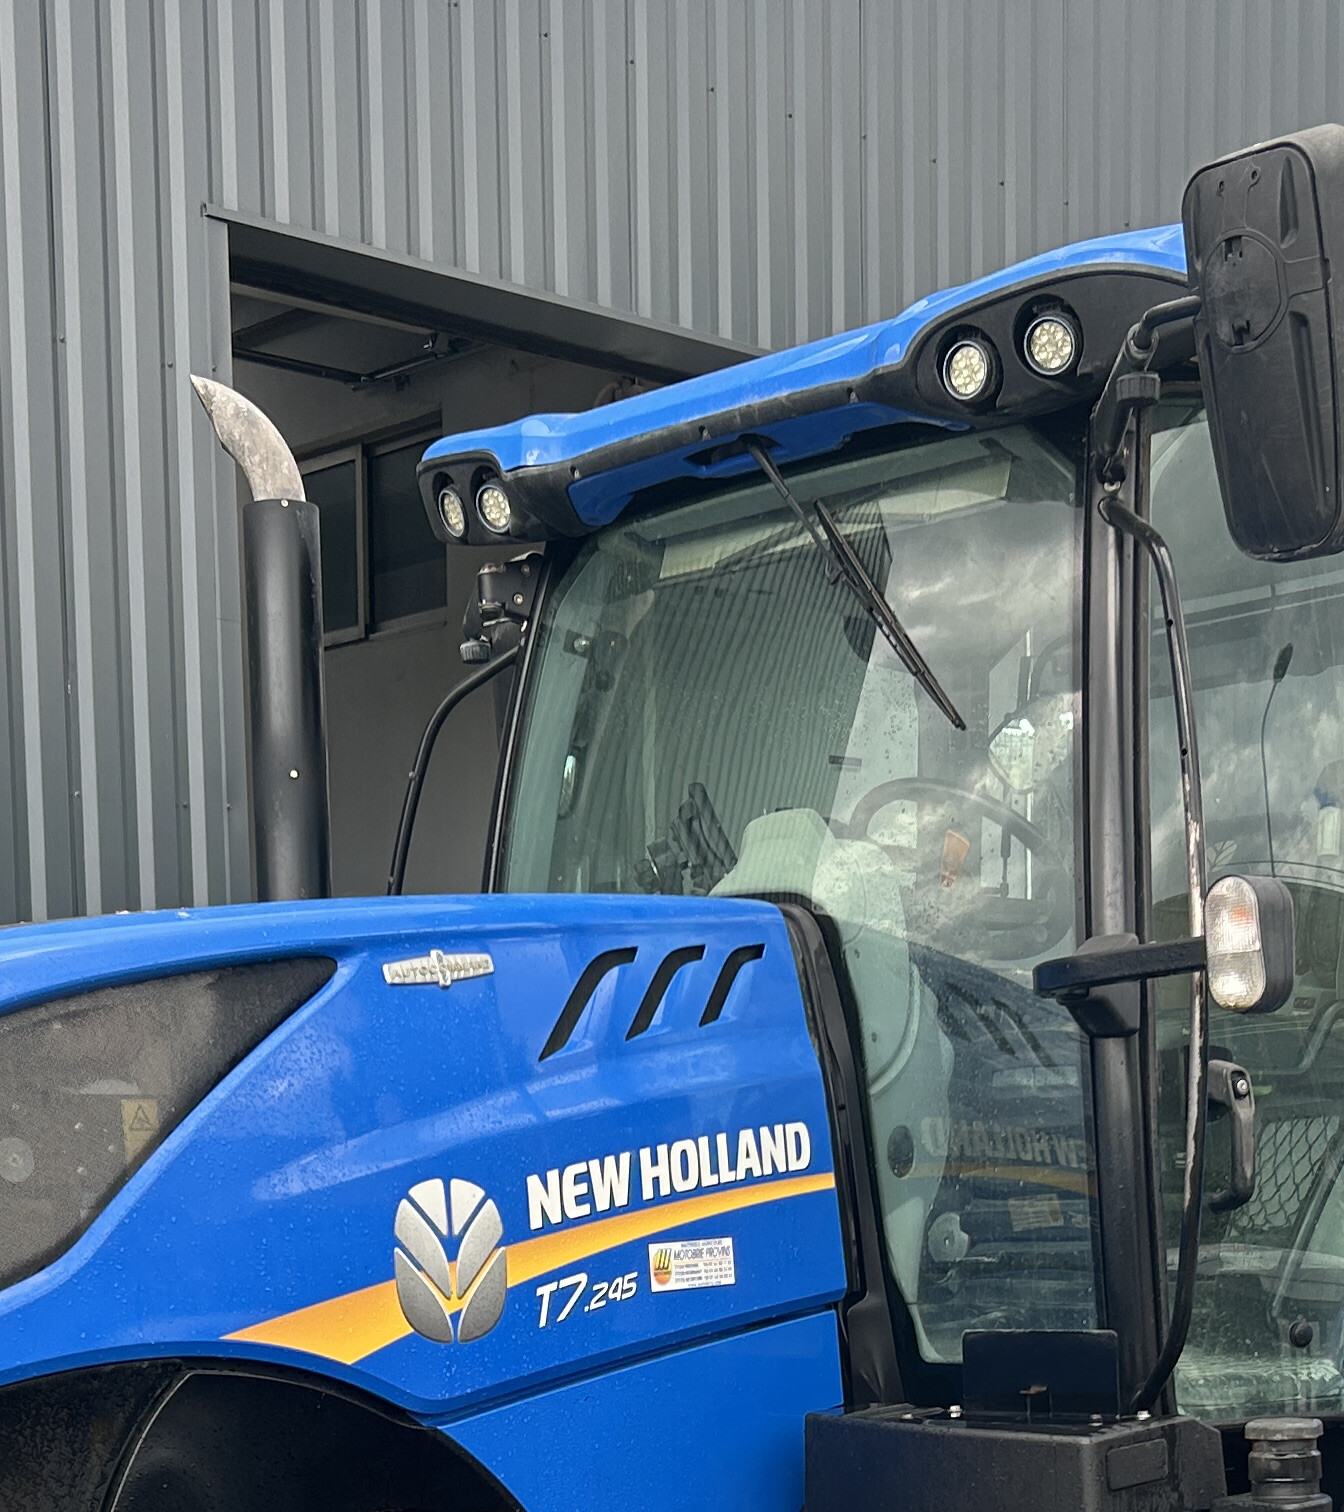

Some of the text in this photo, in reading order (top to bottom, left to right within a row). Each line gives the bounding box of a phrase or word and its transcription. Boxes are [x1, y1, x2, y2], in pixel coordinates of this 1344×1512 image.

[526, 1121, 811, 1231] NEW HOLLAND
[535, 1272, 638, 1329] T7.245
